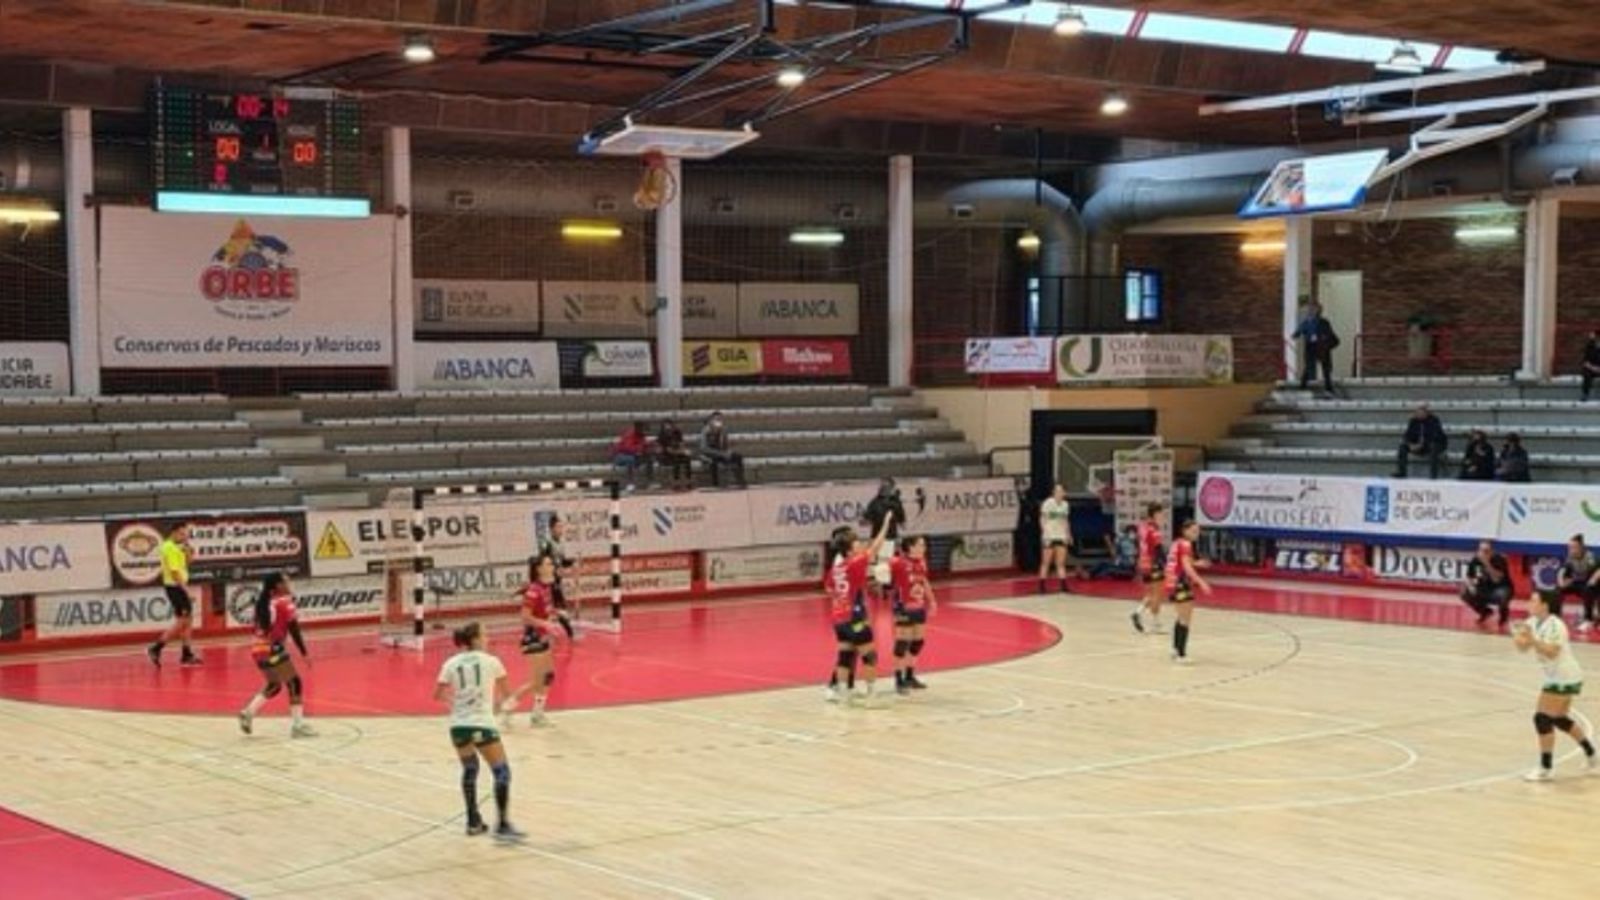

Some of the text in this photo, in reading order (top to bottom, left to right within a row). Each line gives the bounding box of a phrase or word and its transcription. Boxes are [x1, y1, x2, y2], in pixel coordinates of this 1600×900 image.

[293, 142, 317, 163] 00
[198, 266, 299, 300] ORBE
[114, 336, 381, 357] Conservas de Pescados y Mariscos
[717, 348, 749, 363] GIA
[935, 489, 1017, 512] MARCOTE
[1393, 506, 1409, 520] DE
[357, 517, 482, 543] ELEPOR
[456, 663, 481, 689] 11
